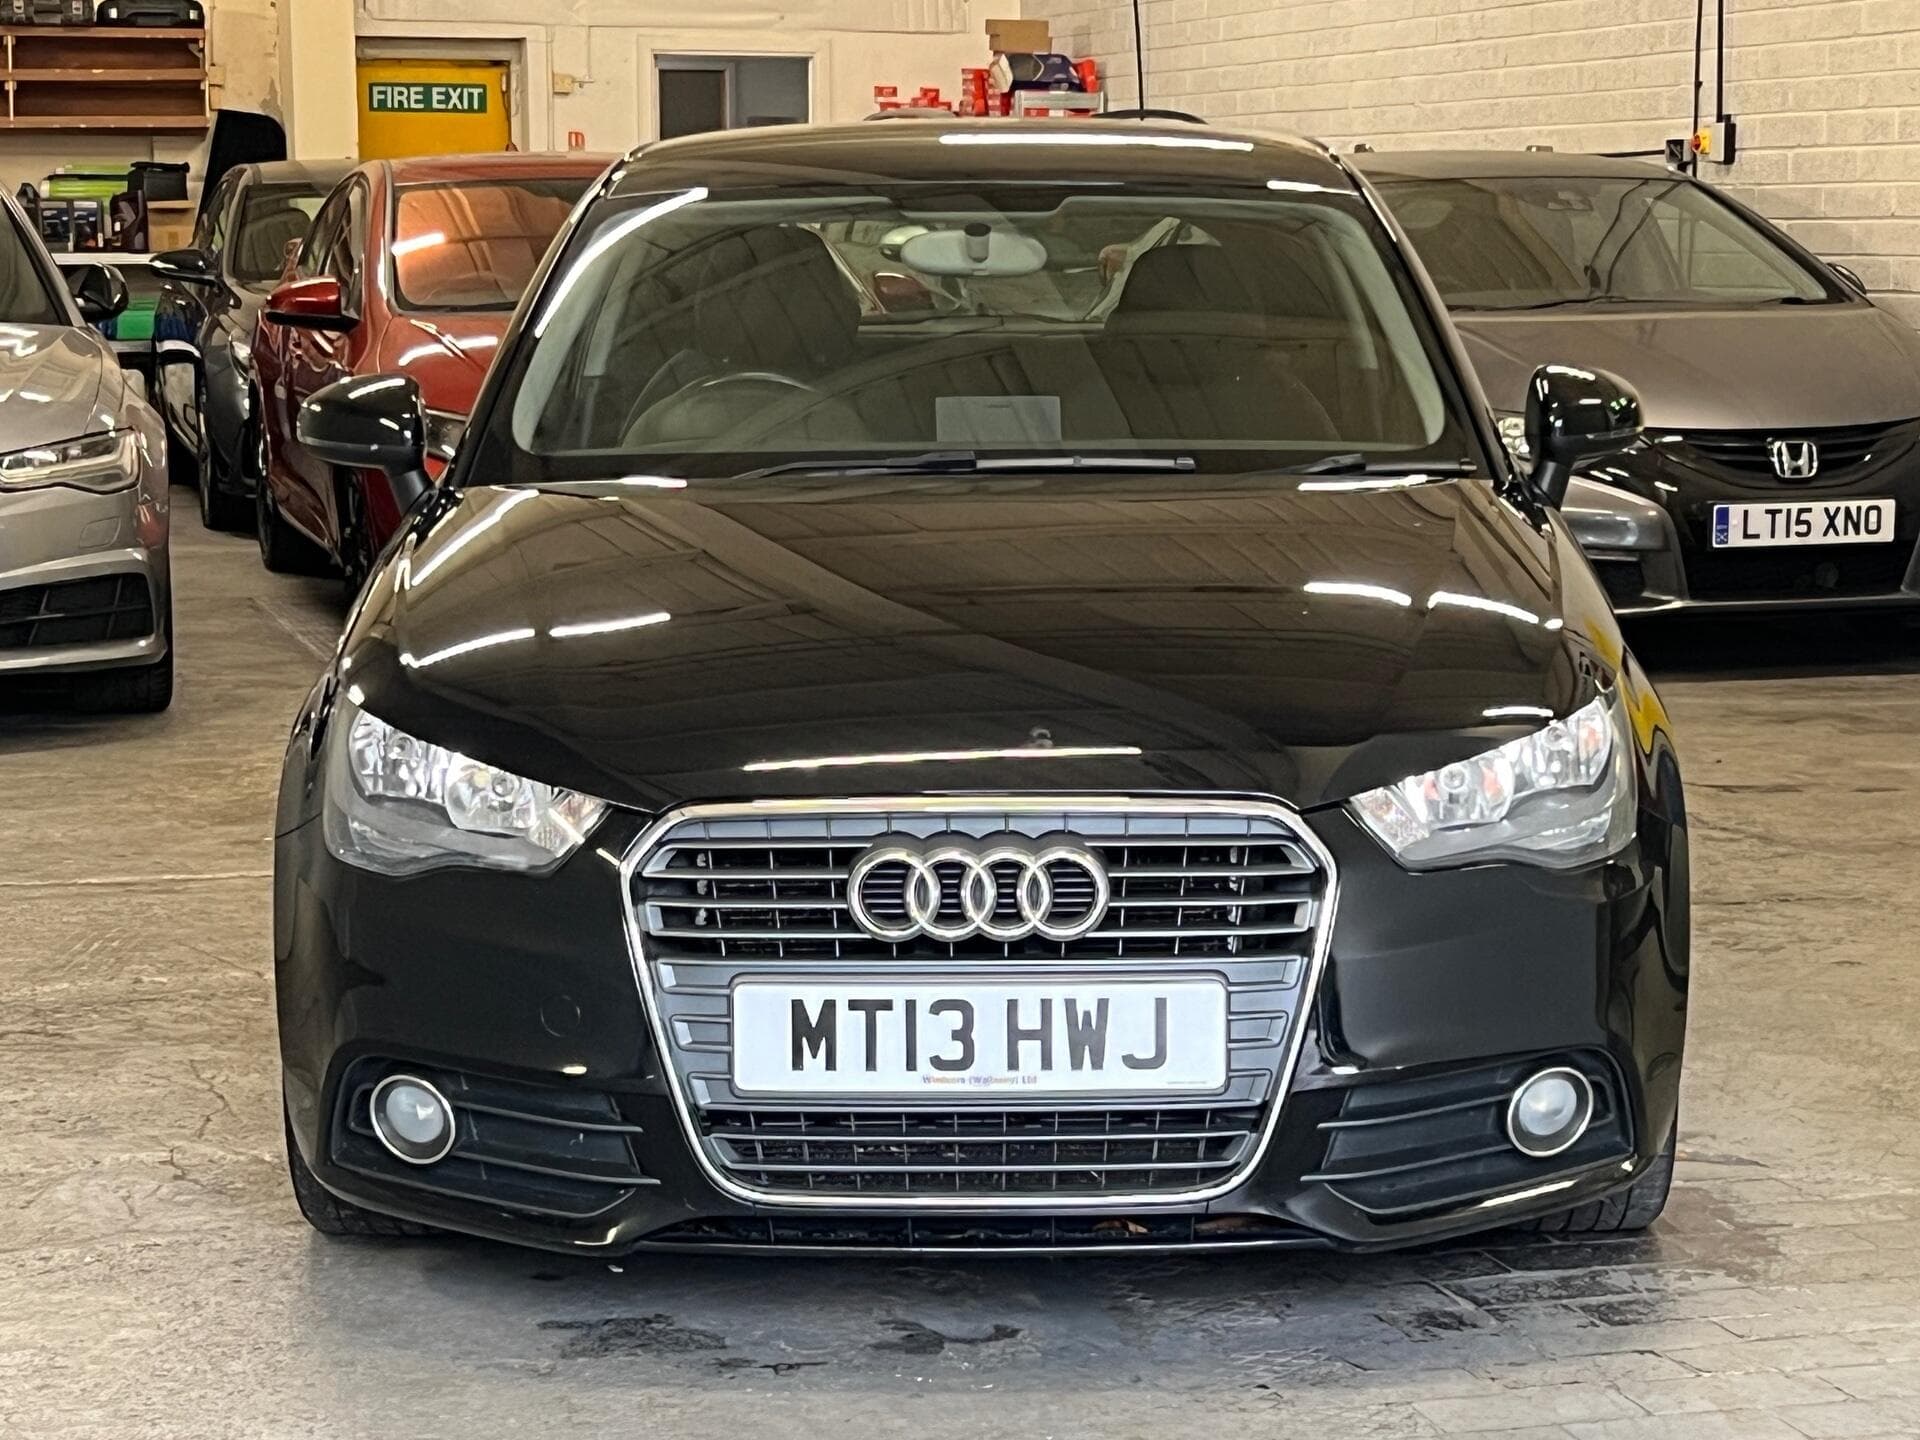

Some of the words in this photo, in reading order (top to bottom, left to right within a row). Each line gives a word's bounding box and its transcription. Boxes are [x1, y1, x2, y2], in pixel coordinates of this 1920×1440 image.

[372, 85, 424, 109] FIRE
[432, 86, 484, 110] EXIT
[1742, 507, 1813, 540] LT15
[1823, 505, 1882, 537] XNO
[791, 999, 975, 1072] MT13
[1006, 998, 1167, 1071] HWJ
